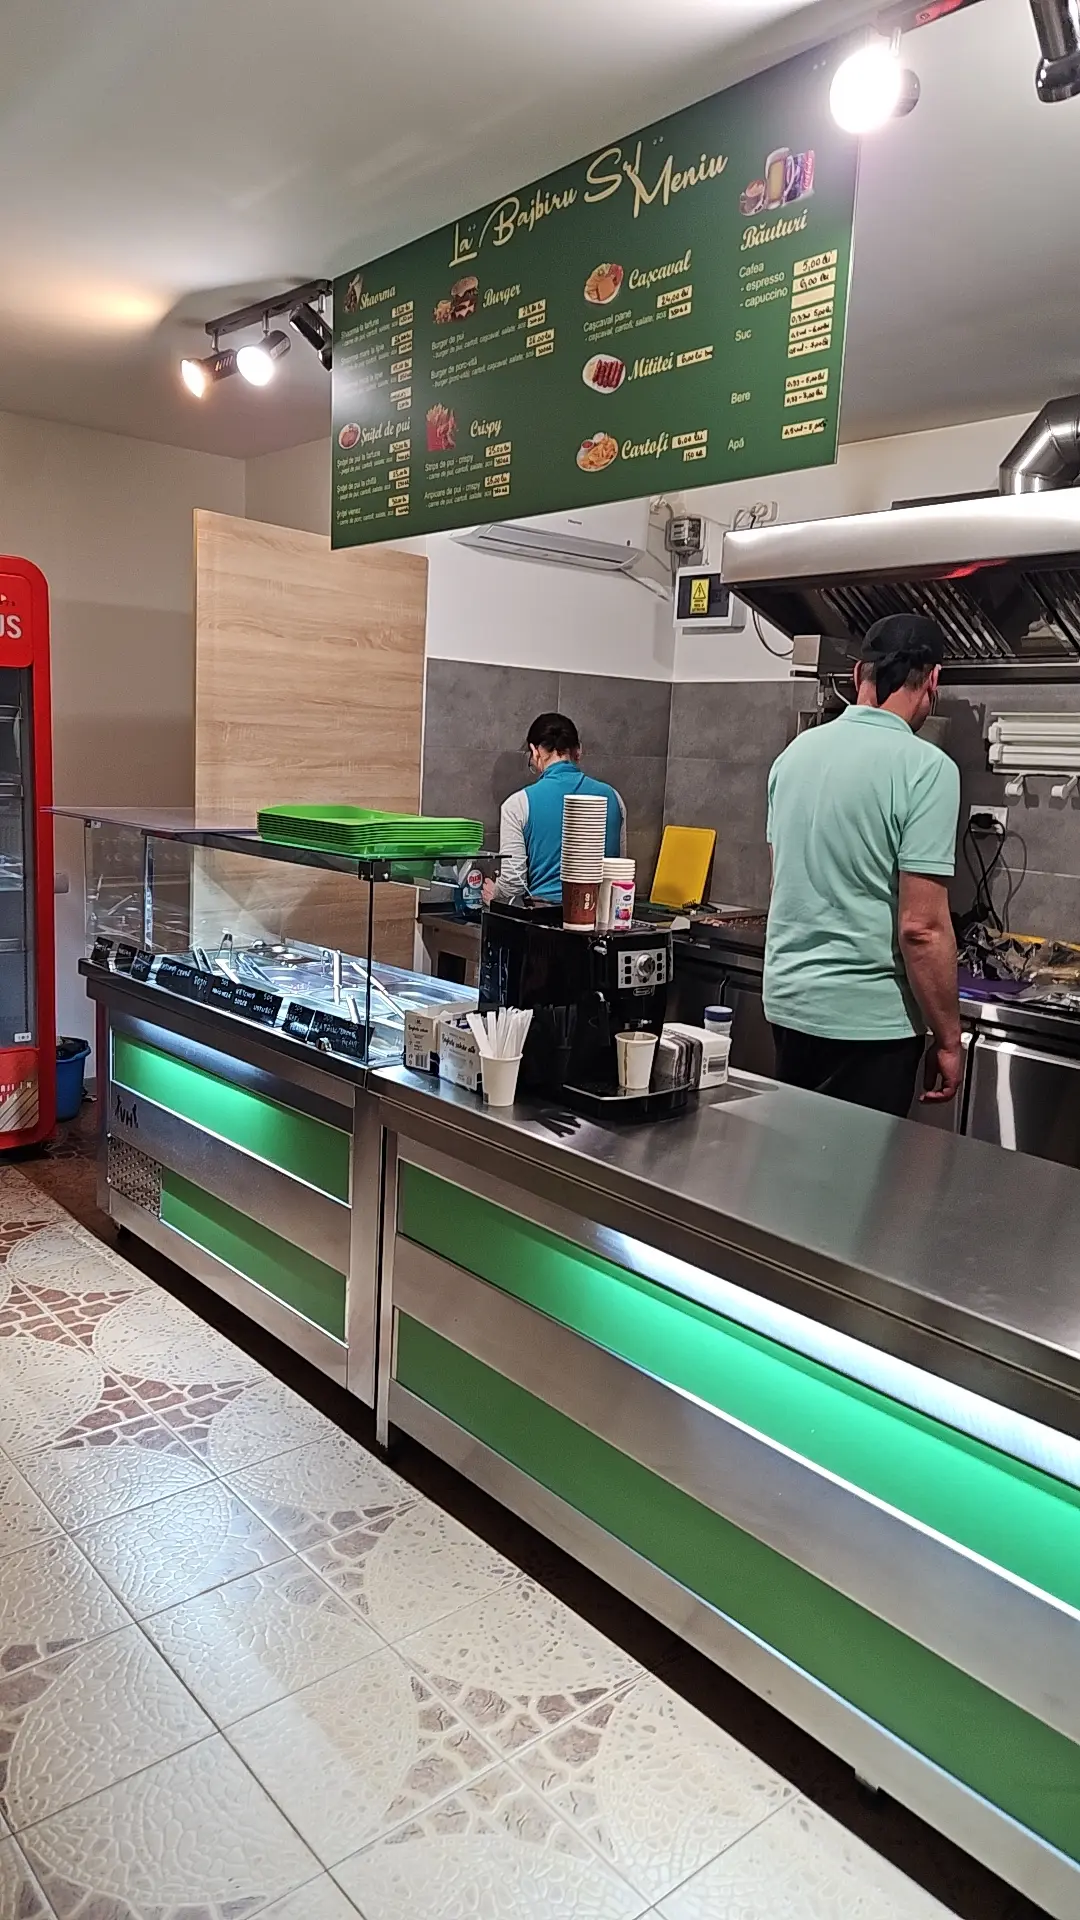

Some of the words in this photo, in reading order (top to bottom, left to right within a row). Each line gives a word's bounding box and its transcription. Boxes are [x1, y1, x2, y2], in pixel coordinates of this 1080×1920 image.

[627, 154, 728, 218] Meniu
[740, 208, 808, 250] Băuturi
[739, 261, 765, 278] Cafea
[745, 271, 786, 292] espresso
[482, 284, 522, 309] Burger
[744, 286, 789, 307] capuccino
[735, 329, 753, 342] Suc
[628, 352, 674, 381] Mititei
[731, 391, 751, 405] Bere
[384, 420, 395, 438] de
[396, 416, 411, 439] pui
[470, 419, 503, 439] Crispy
[621, 431, 669, 460] Cartofi
[728, 437, 745, 452] Apă
